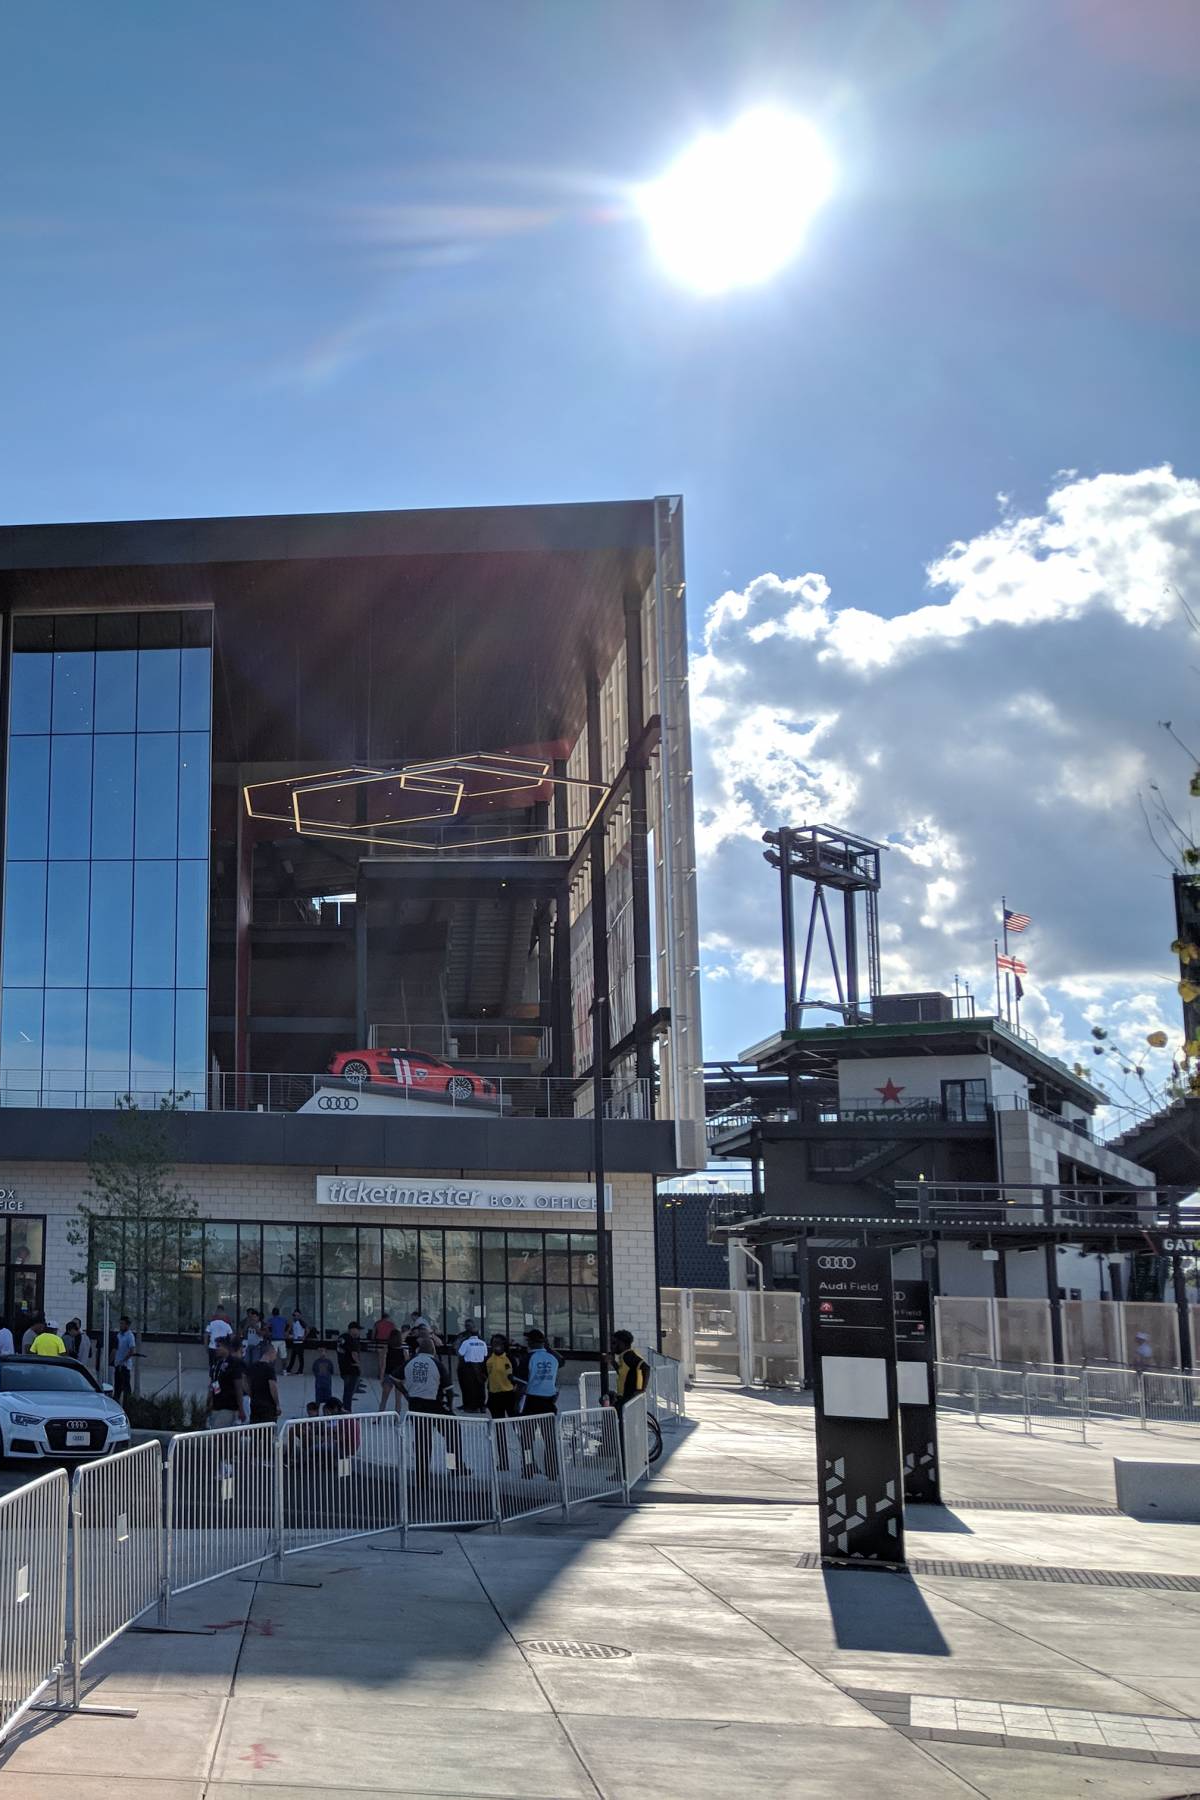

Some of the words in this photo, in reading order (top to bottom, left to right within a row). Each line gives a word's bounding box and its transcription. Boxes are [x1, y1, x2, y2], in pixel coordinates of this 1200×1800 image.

[329, 1180, 480, 1207] ticketmaster
[490, 1195, 527, 1208] BOX
[1163, 1238, 1199, 1251] GAT
[335, 1247, 343, 1258] 4
[521, 1251, 530, 1264] 7
[586, 1254, 596, 1266] 8
[819, 1281, 848, 1291] Audi
[849, 1282, 879, 1292] Field
[413, 1361, 429, 1370] CSC
